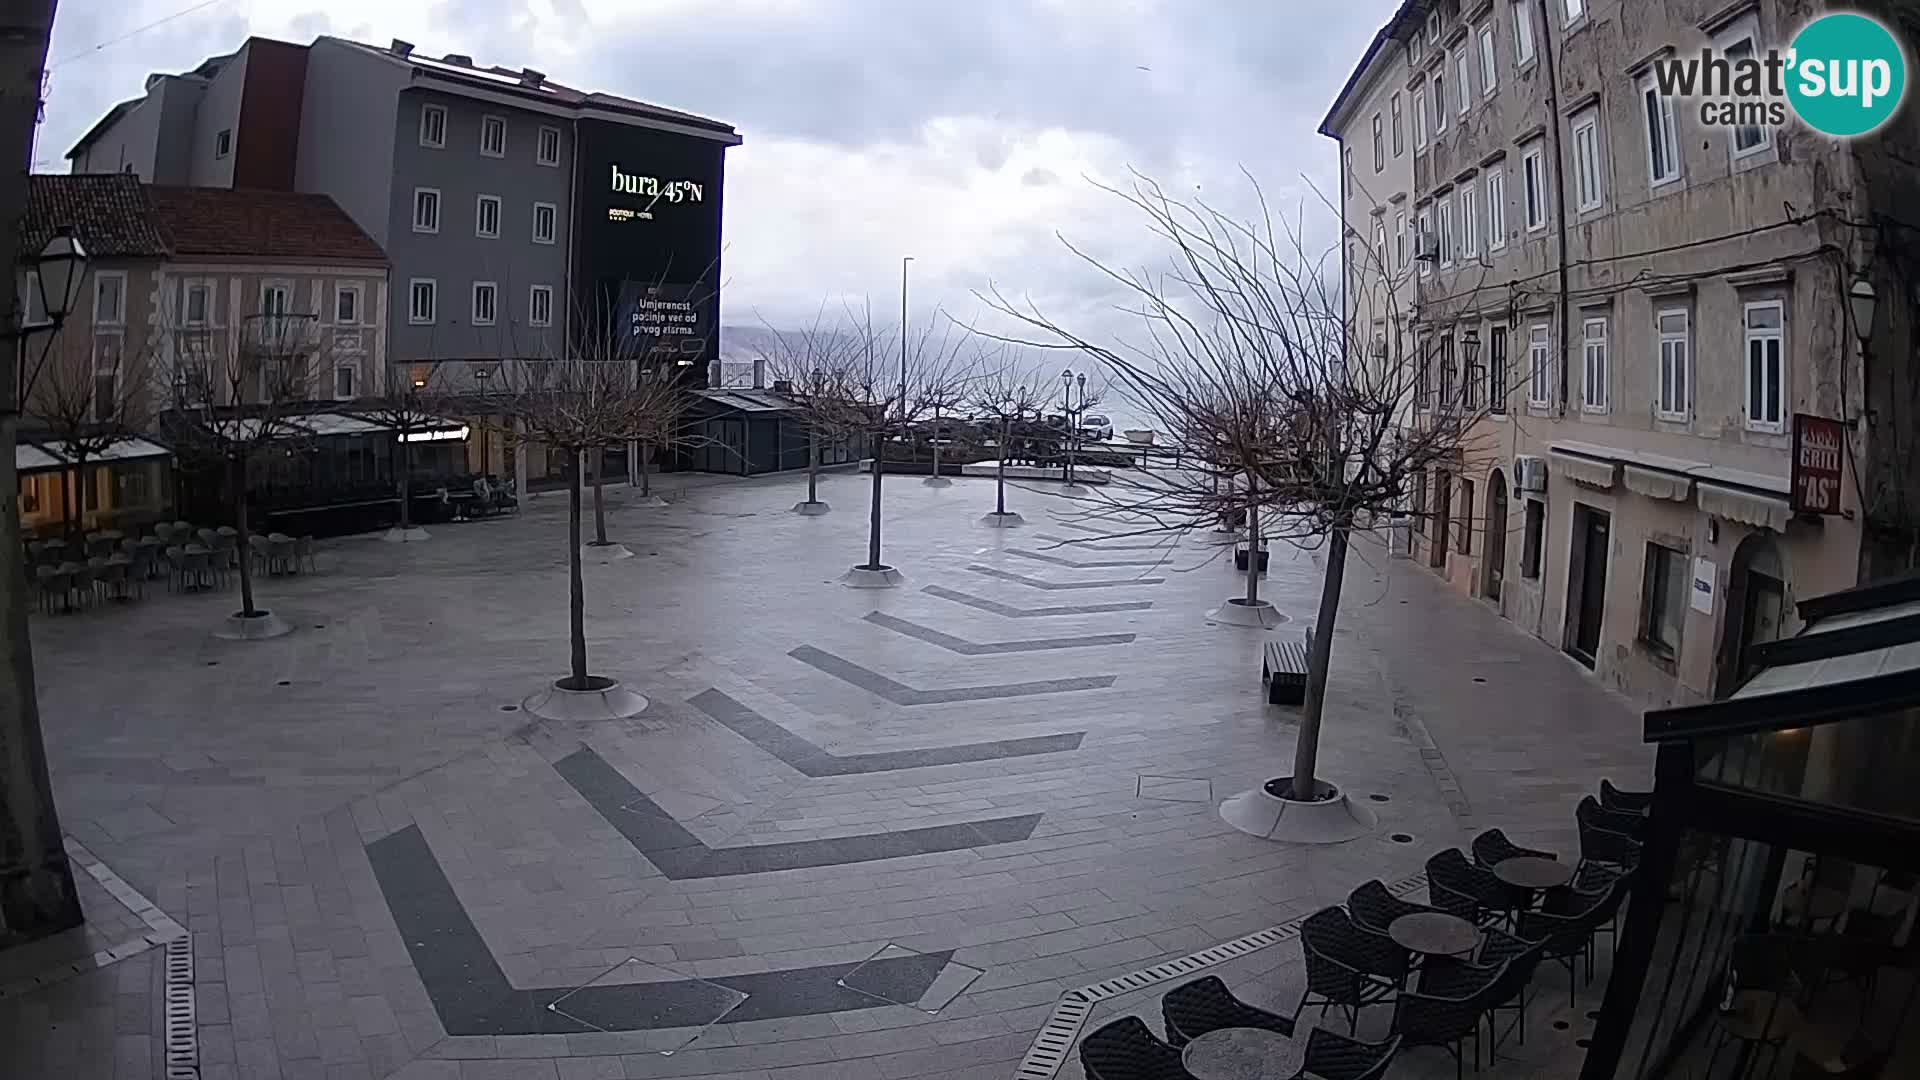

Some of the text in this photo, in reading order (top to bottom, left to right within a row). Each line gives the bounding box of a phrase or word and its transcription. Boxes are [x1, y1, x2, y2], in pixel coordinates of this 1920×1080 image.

[612, 165, 658, 196] bura
[685, 312, 697, 323] od
[633, 324, 660, 337] prvog
[1800, 448, 1839, 471] GRILL
